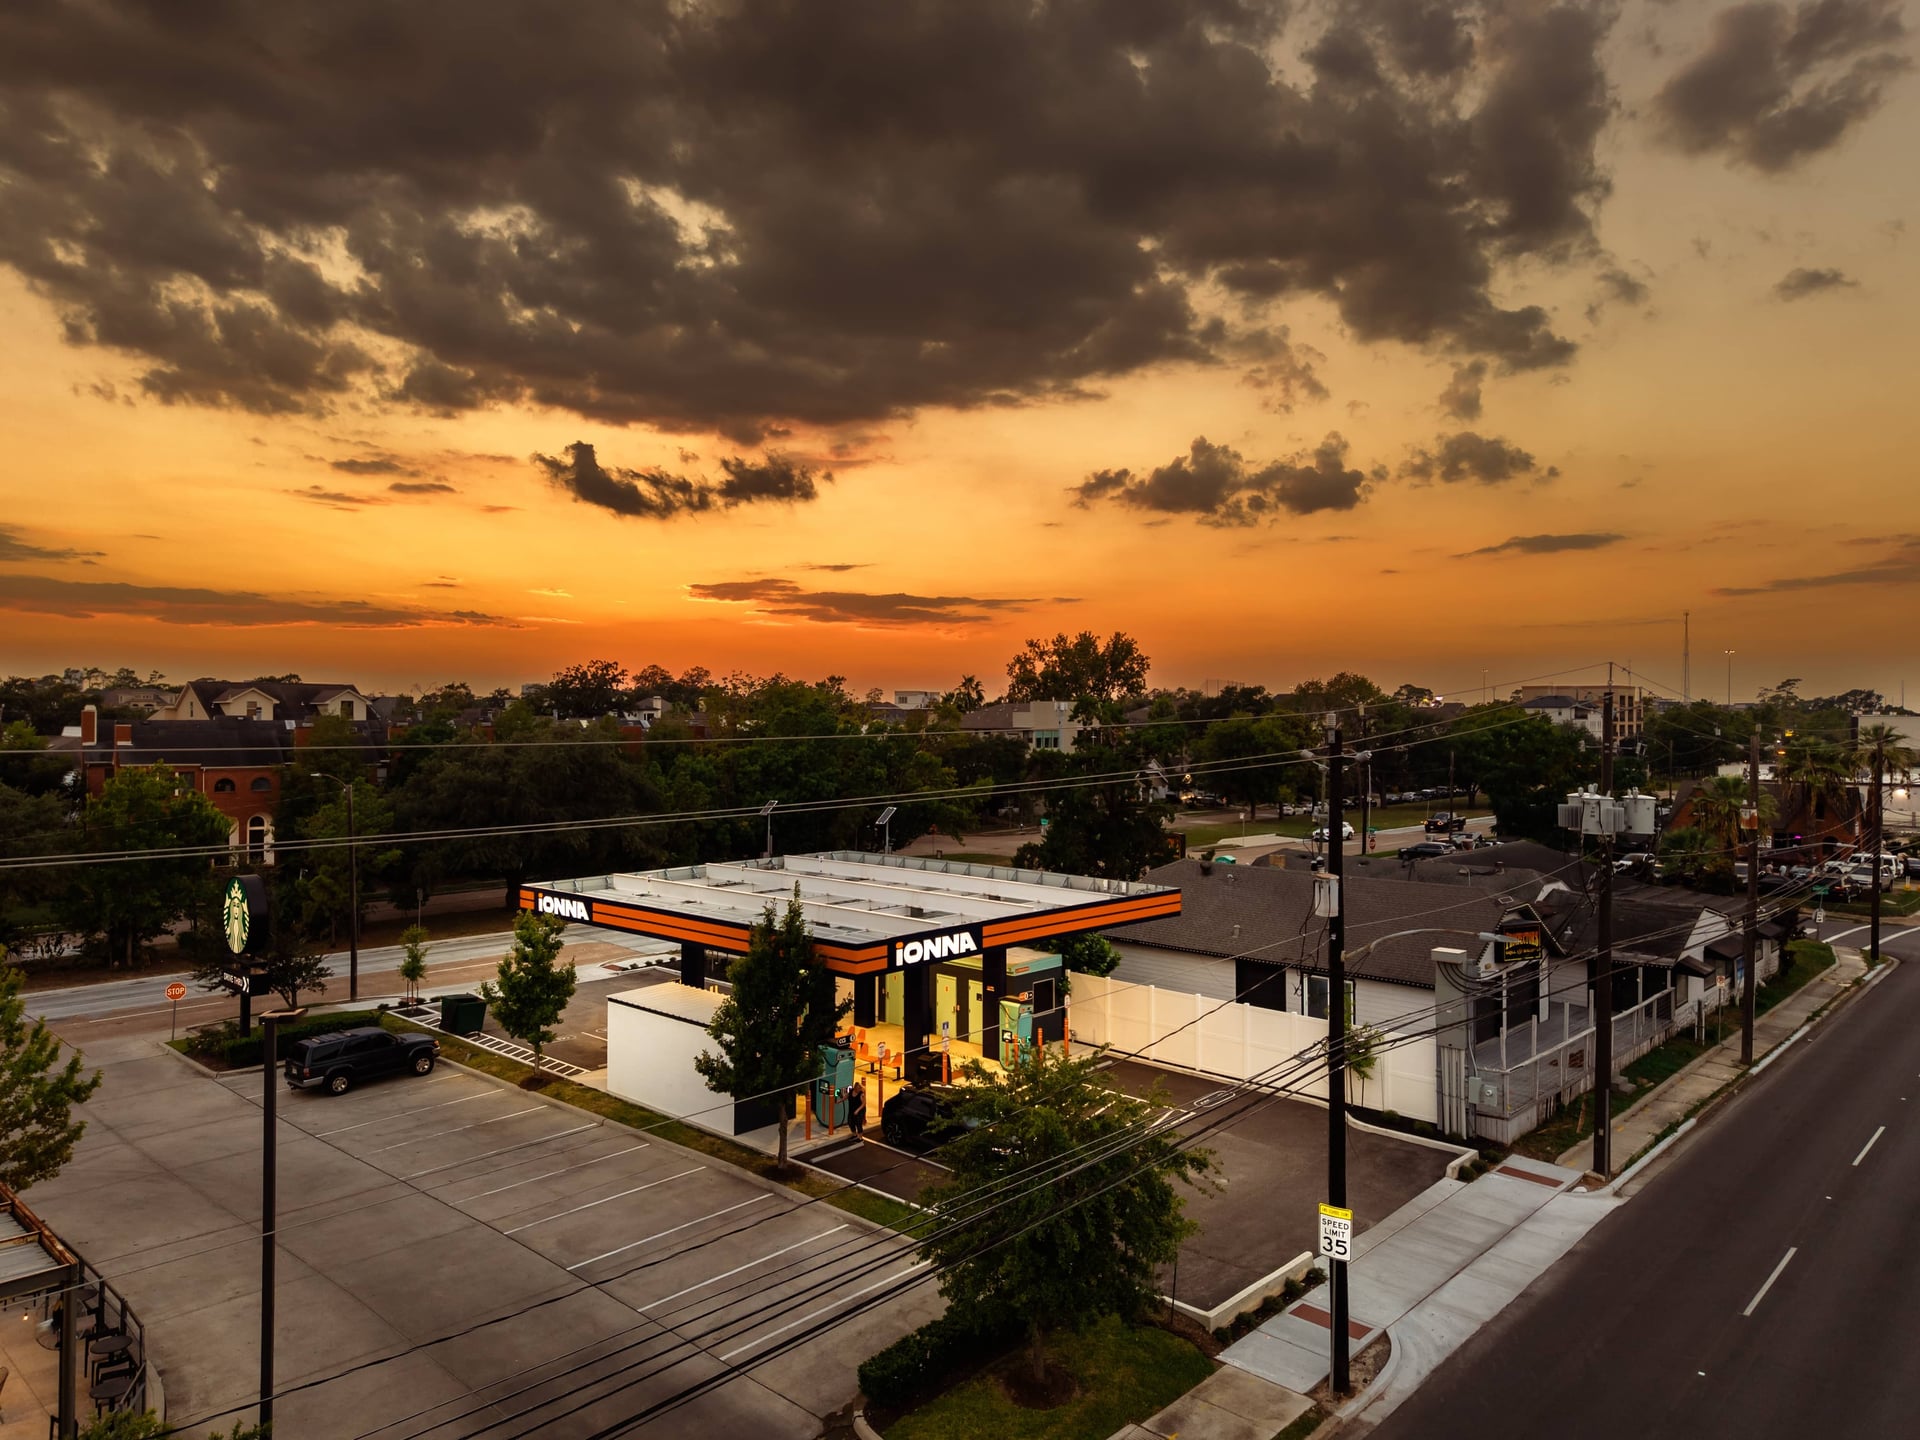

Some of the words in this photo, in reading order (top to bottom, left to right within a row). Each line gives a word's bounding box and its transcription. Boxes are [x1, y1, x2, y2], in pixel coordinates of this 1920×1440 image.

[167, 987, 185, 996] STOP
[1322, 1218, 1349, 1230] SPEED
[1325, 1228, 1345, 1238] LIMIT
[1323, 1236, 1347, 1255] 35
